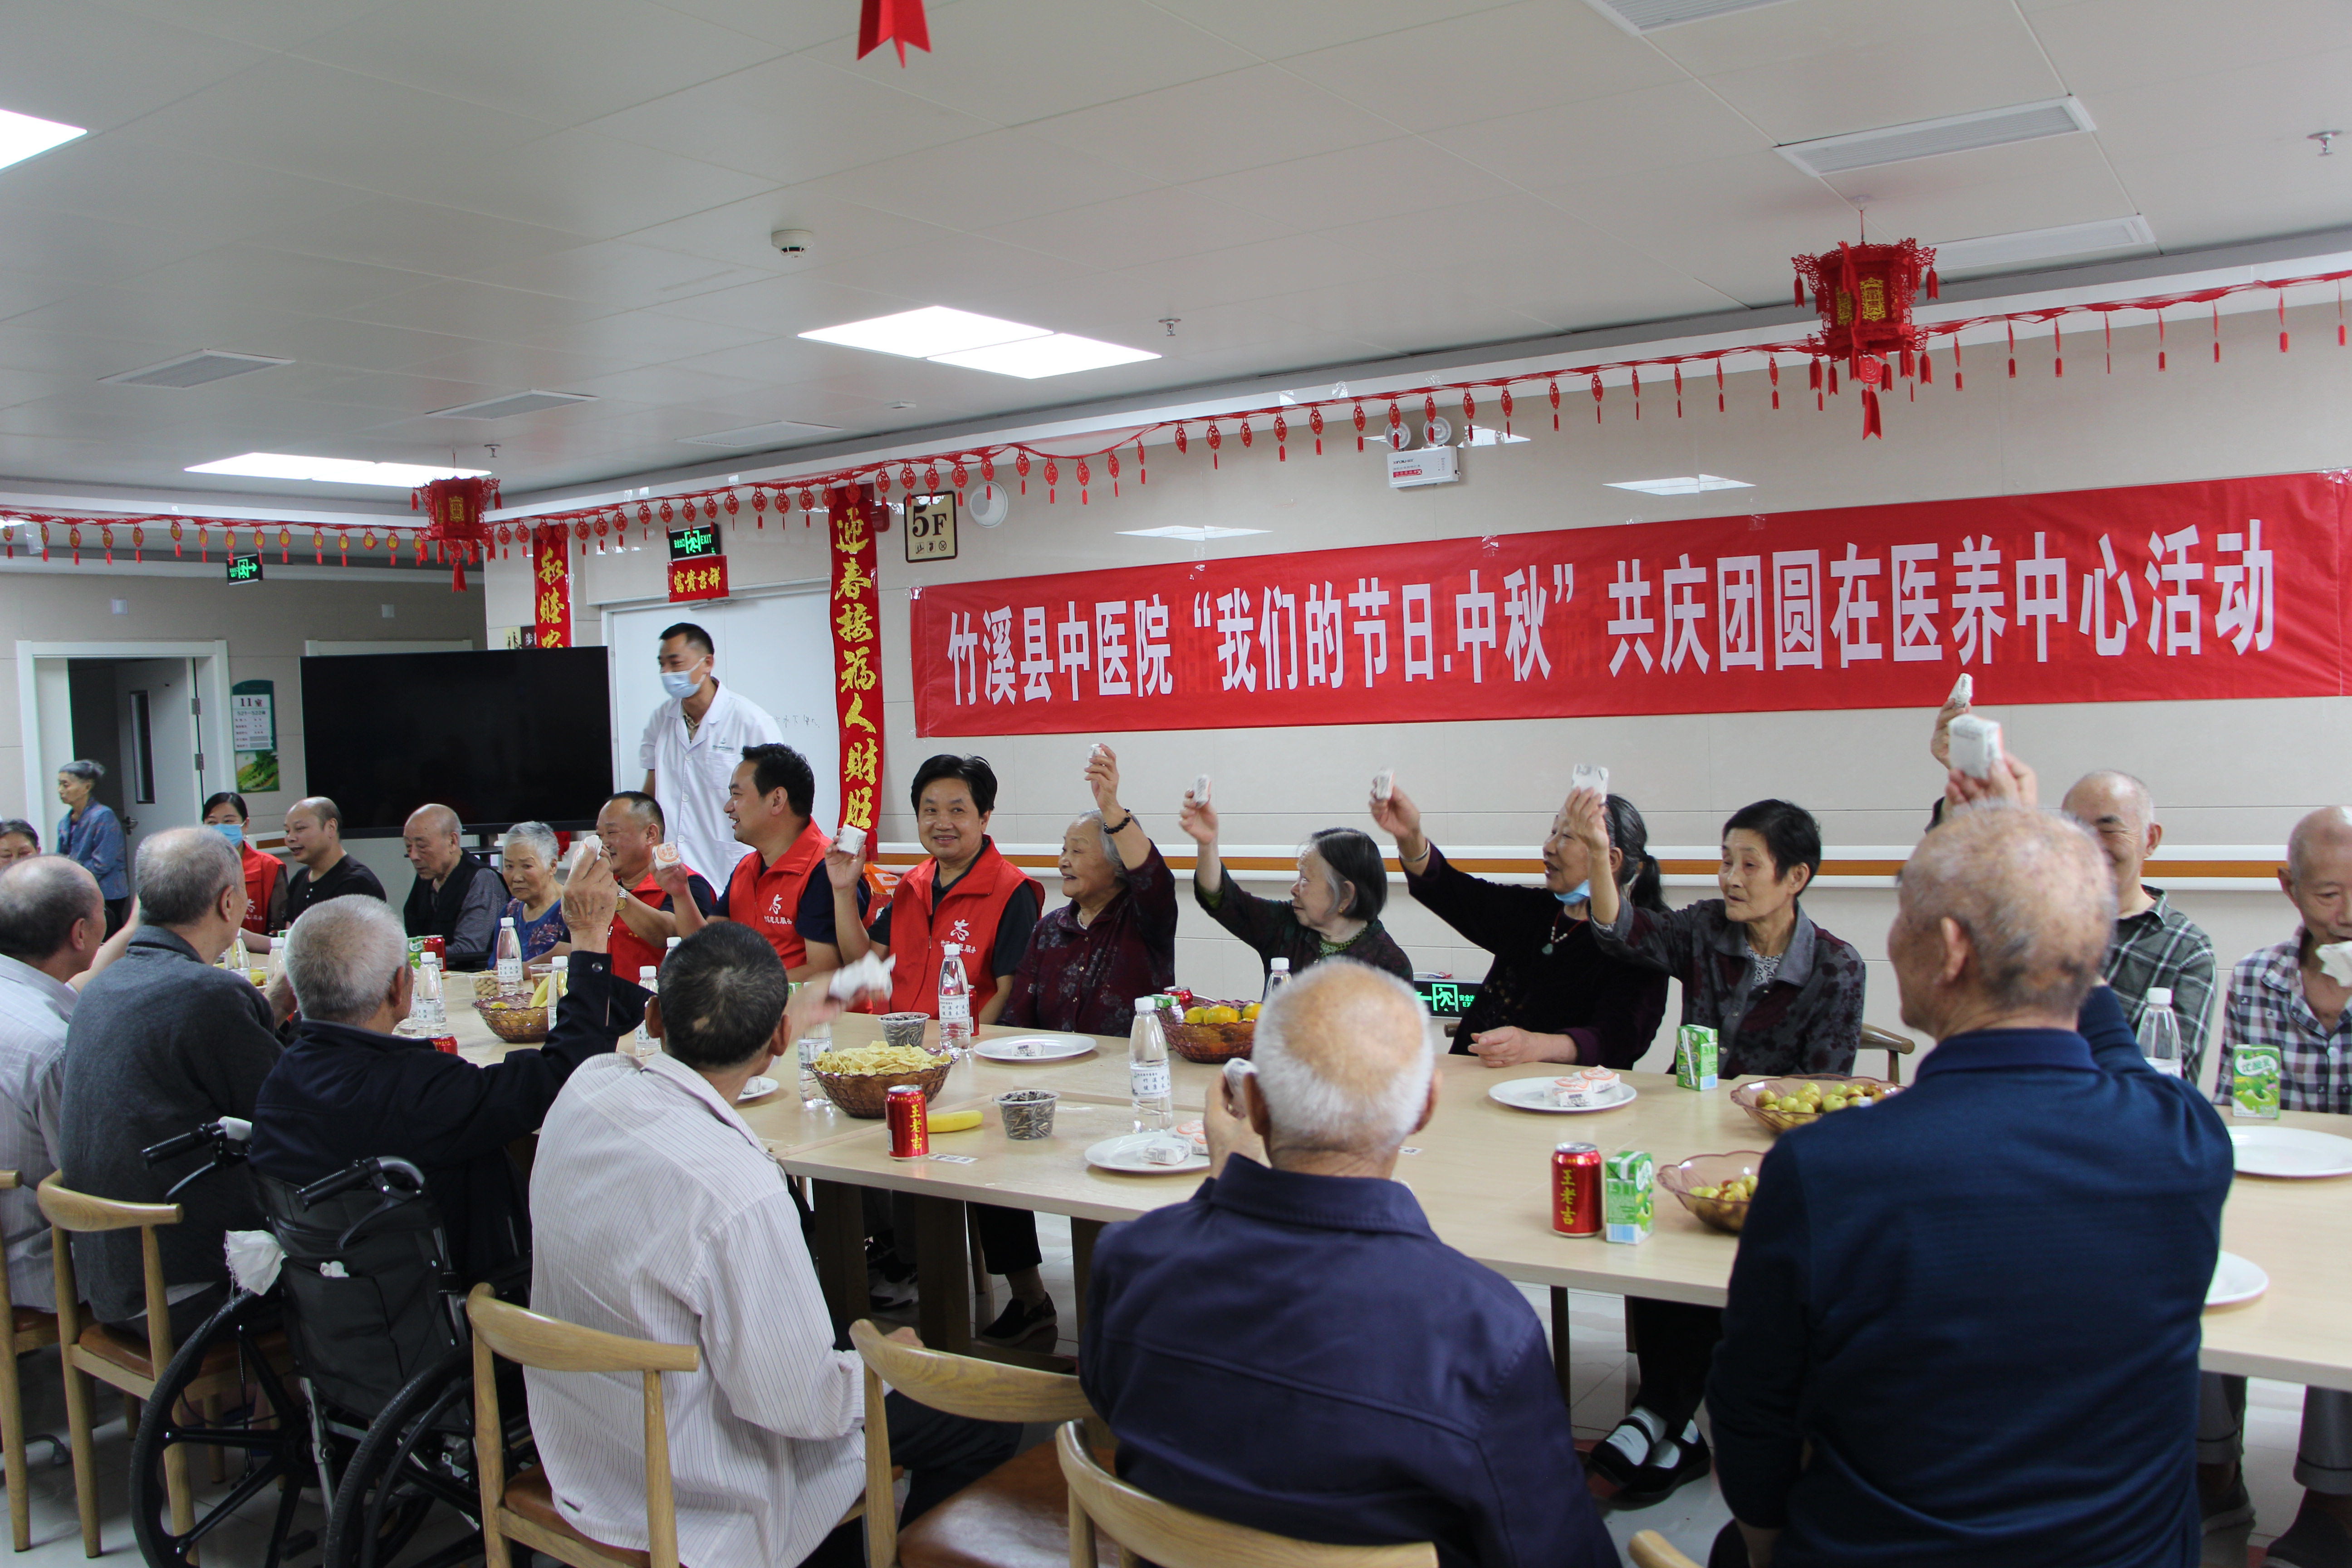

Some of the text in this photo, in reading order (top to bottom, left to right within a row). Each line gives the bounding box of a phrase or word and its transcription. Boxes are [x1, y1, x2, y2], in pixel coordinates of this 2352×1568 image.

[701, 534, 711, 544] EXIT
[912, 505, 947, 537] 5F
[947, 593, 1173, 706] 竹溪县中医院
[1607, 519, 2273, 677] 共庆团圆在医养中心活动
[524, 632, 537, 646] 步
[910, 1104, 922, 1150] 王老吉
[1560, 1169, 1577, 1225] 王老吉
